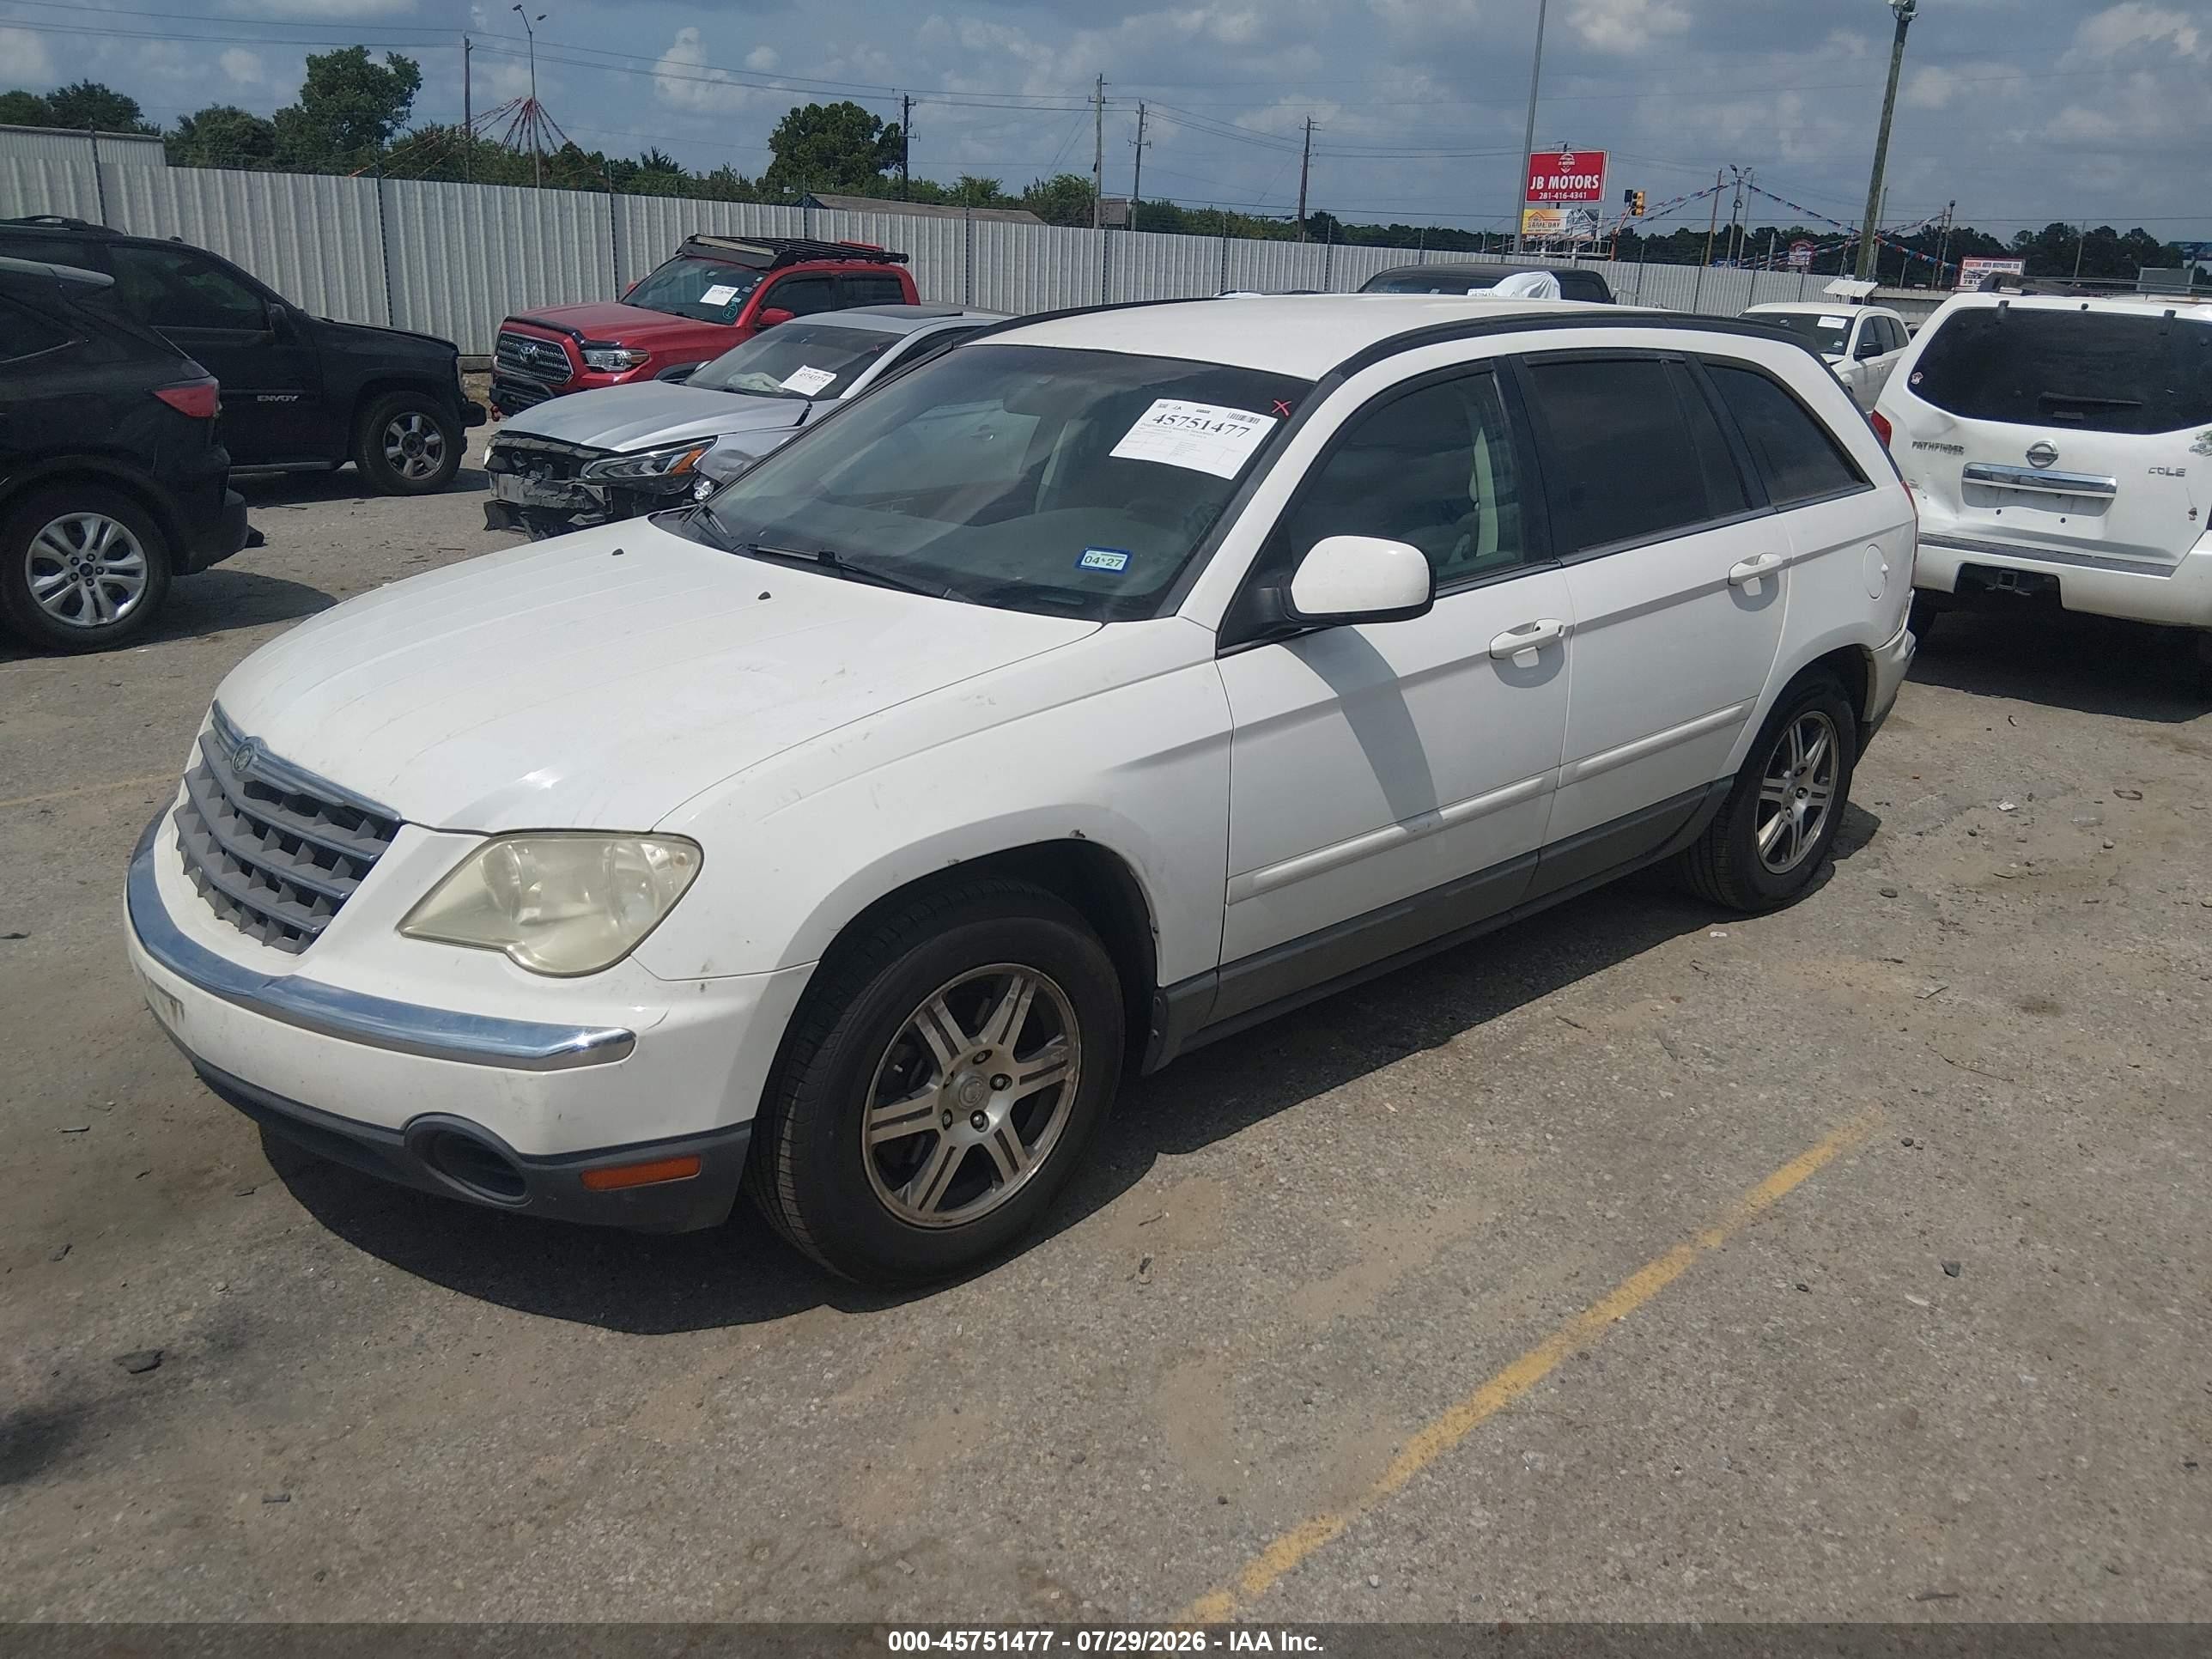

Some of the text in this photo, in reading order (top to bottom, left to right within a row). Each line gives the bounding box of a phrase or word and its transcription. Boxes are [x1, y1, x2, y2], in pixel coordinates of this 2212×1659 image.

[1530, 174, 1600, 190] JB MOTORS
[1538, 191, 1587, 200] 281-416-4341
[1152, 413, 1251, 439] 45751477
[1911, 441, 1965, 456] PATHFINDER
[1084, 556, 1101, 565] 04
[1105, 558, 1124, 568] 27
